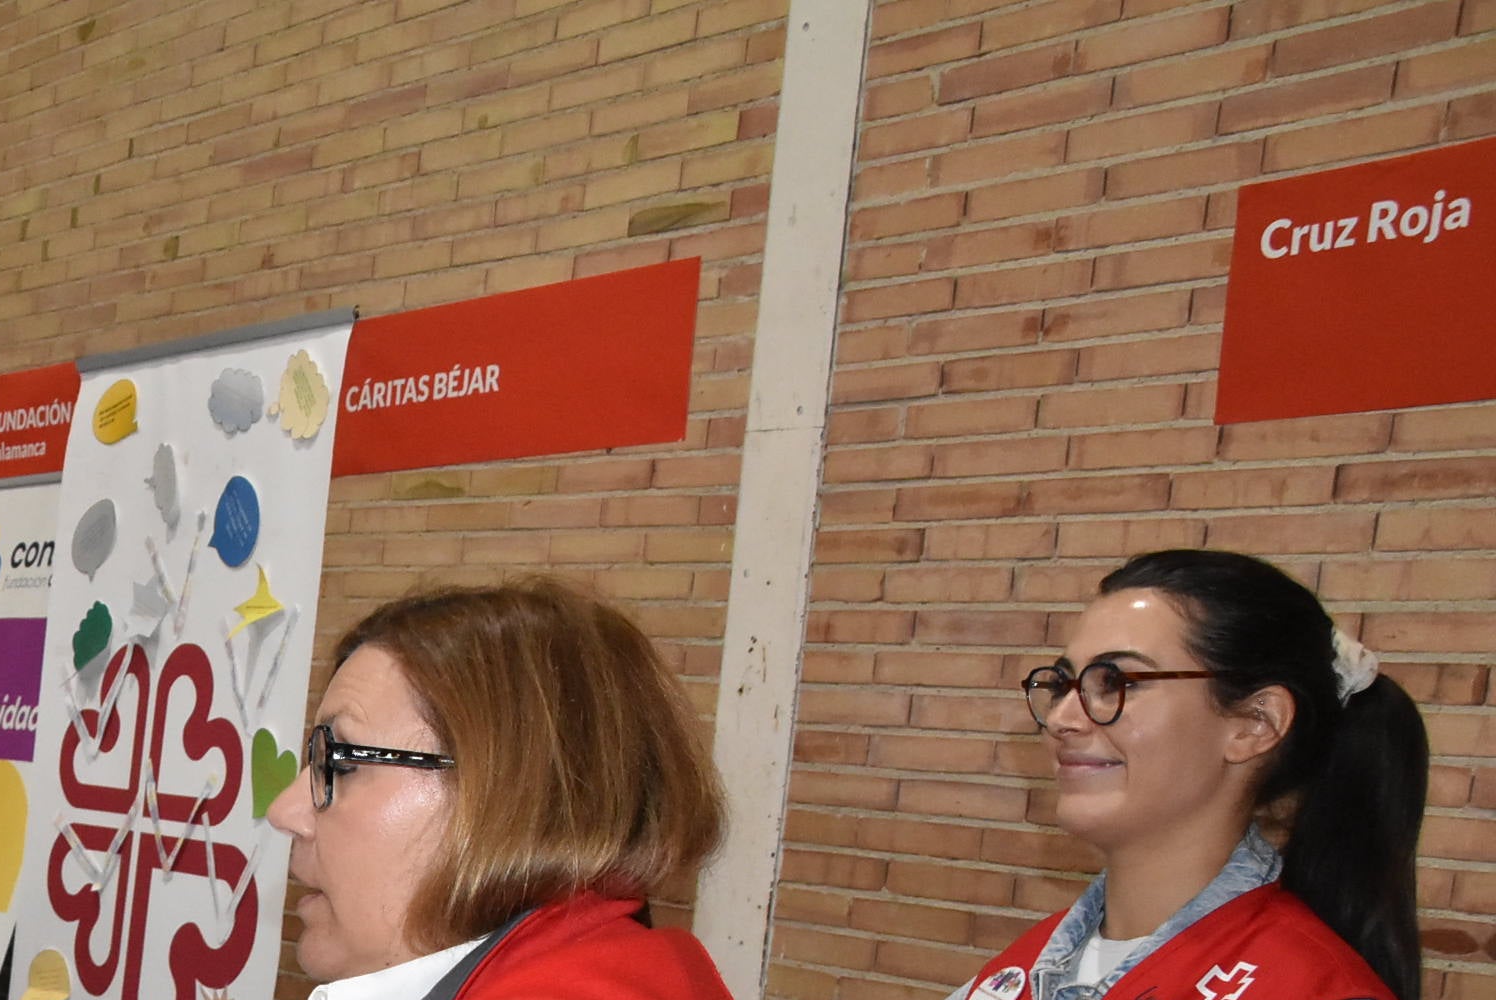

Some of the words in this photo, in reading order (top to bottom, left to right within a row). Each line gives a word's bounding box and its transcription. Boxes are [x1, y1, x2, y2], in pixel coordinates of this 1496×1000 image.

[1260, 218, 1358, 260] Cruz
[1367, 189, 1471, 244] Roja
[345, 378, 429, 413] CÁRITAS
[433, 364, 500, 400] BÉJAR
